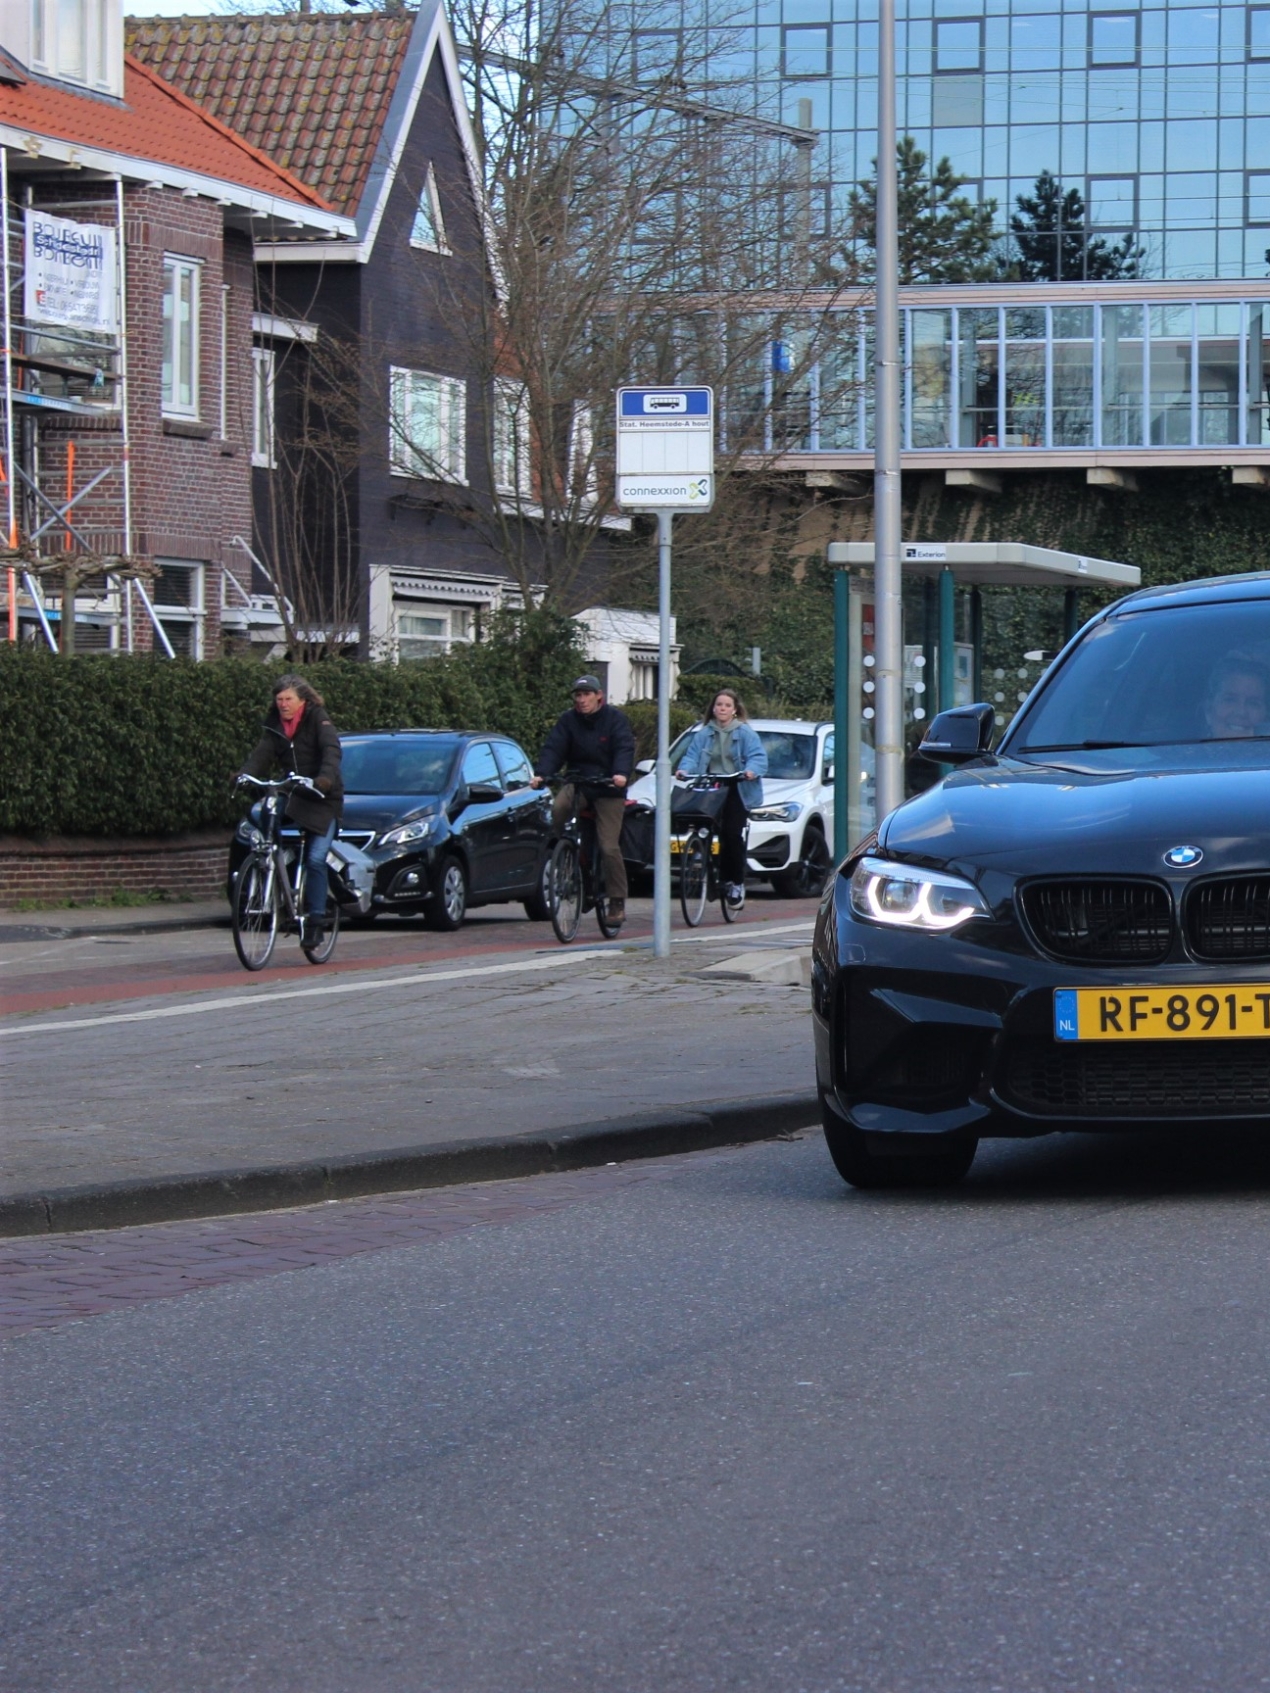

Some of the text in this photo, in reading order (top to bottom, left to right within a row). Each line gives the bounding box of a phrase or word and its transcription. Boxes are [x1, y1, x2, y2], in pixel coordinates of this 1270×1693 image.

[623, 487, 687, 496] connexxion
[917, 550, 946, 558] Exterion
[1058, 1020, 1075, 1032] NL
